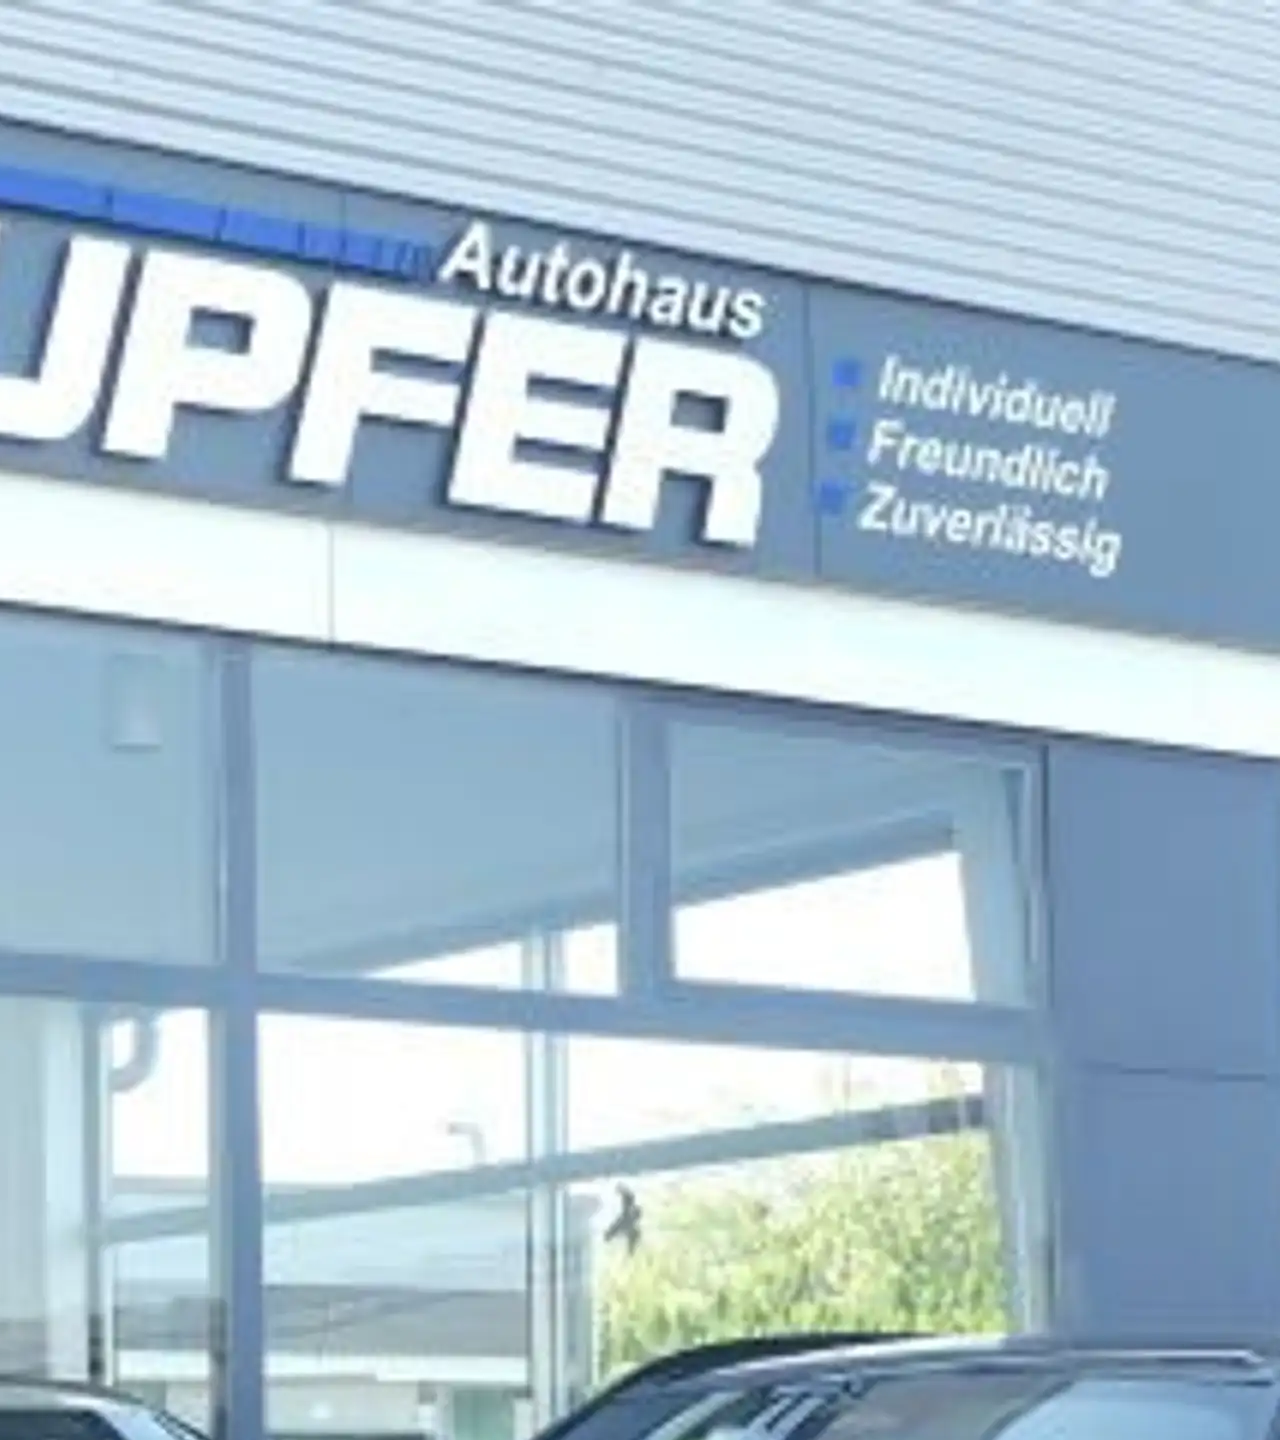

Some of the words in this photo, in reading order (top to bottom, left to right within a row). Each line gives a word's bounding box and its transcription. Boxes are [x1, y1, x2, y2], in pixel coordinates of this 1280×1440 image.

[439, 220, 766, 337] Autohaus
[878, 354, 1116, 437] Individuell
[868, 417, 1109, 500] Freundlich
[858, 481, 1122, 578] Zuverlässig
